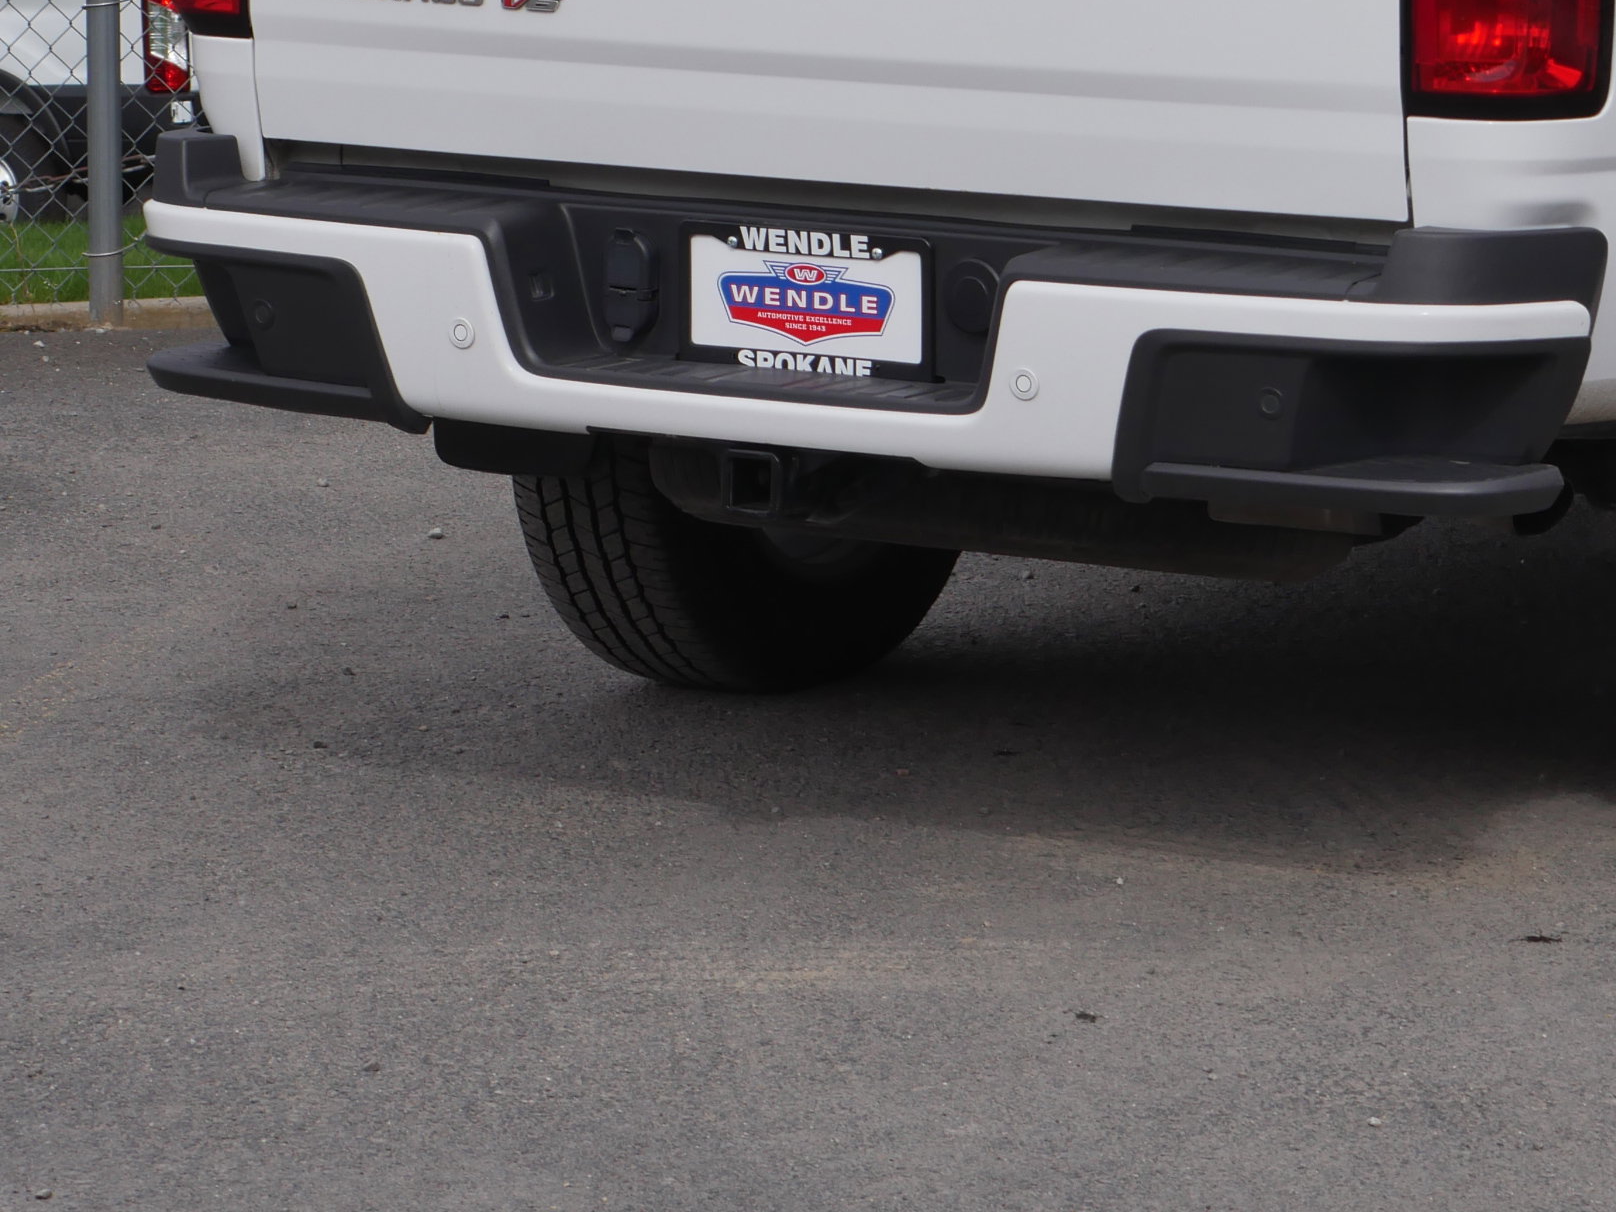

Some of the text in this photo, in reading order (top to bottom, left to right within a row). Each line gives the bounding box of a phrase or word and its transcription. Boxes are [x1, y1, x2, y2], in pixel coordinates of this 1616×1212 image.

[739, 226, 870, 259] WENDLE
[793, 268, 818, 281] W
[731, 284, 878, 315] WENDLE
[757, 312, 852, 326] AUTOMOTIVE EXCELLENCE
[785, 323, 826, 332] SINCE 1943
[738, 349, 872, 377] SPOKANE
